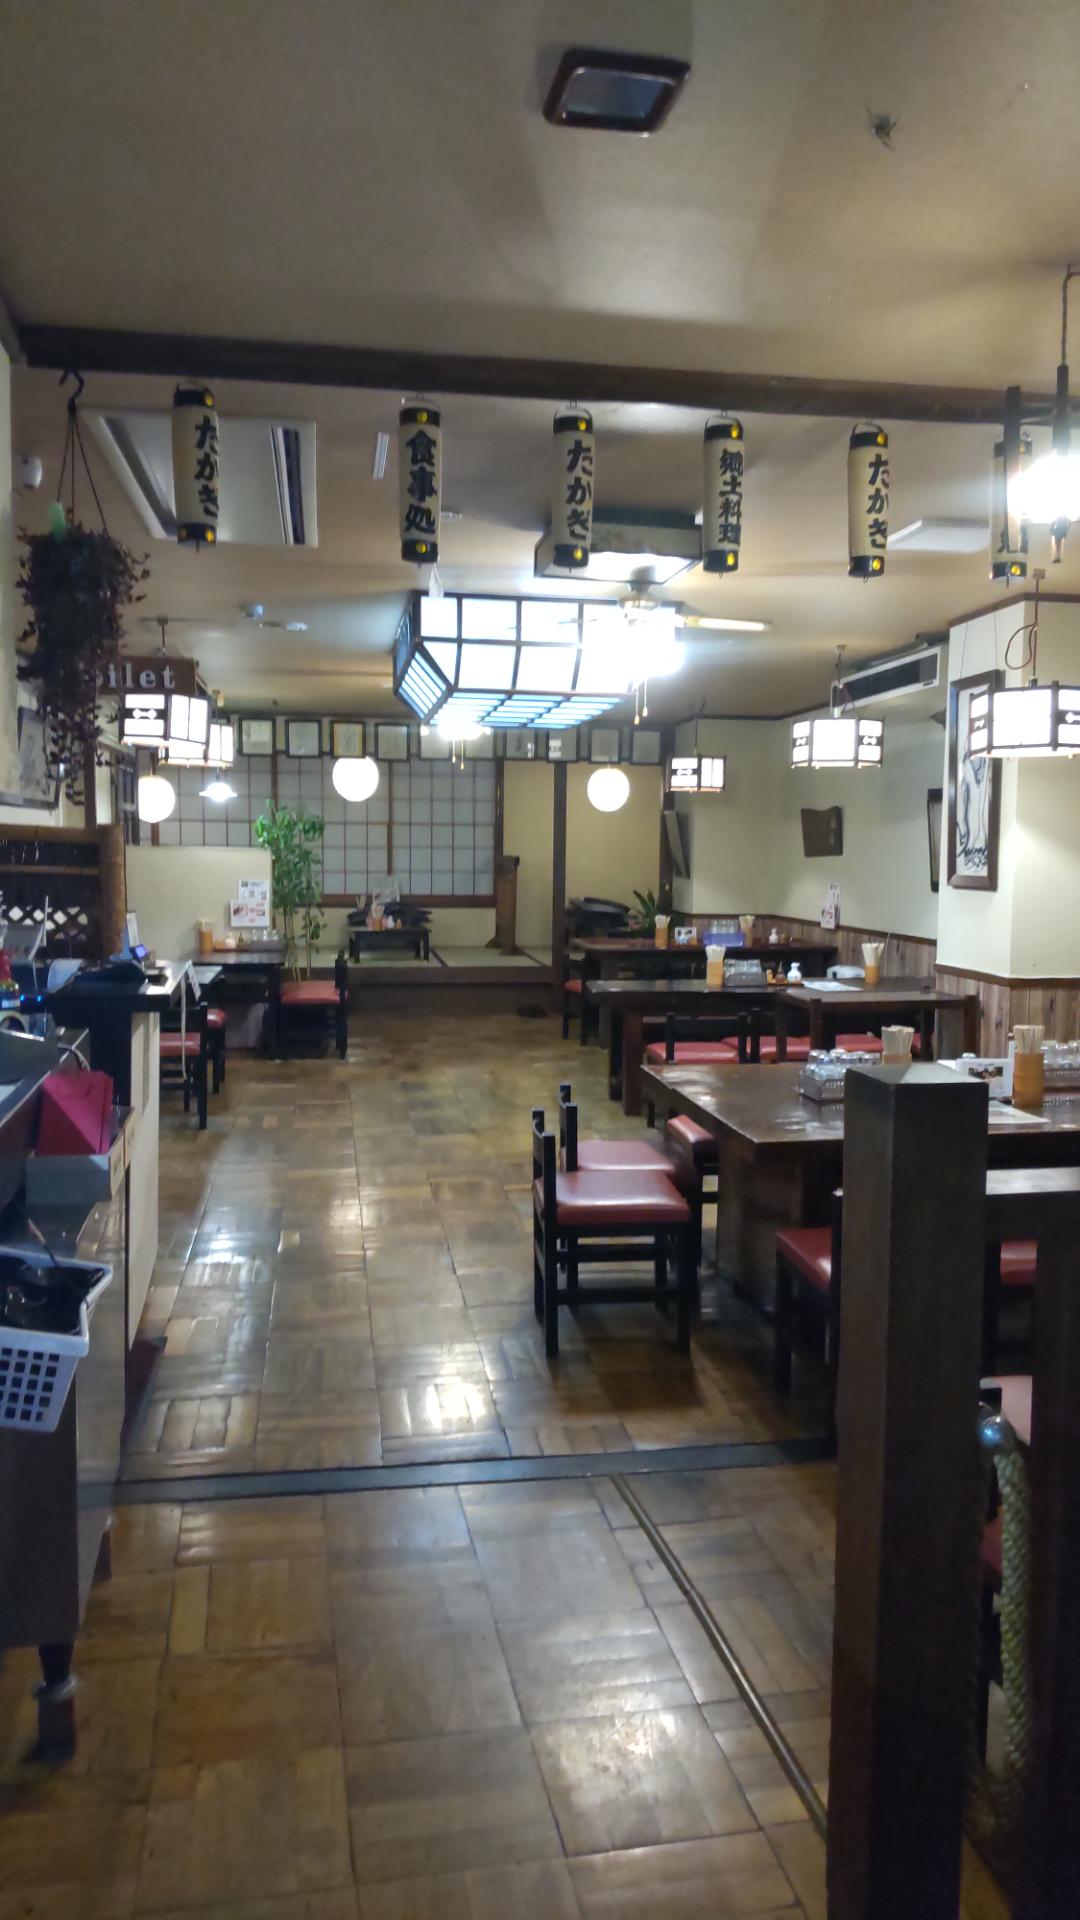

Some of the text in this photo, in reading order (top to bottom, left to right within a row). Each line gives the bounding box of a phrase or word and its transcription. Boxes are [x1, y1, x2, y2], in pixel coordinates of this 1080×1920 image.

[405, 430, 437, 534] 食事処
[719, 448, 744, 546] 郷土料理
